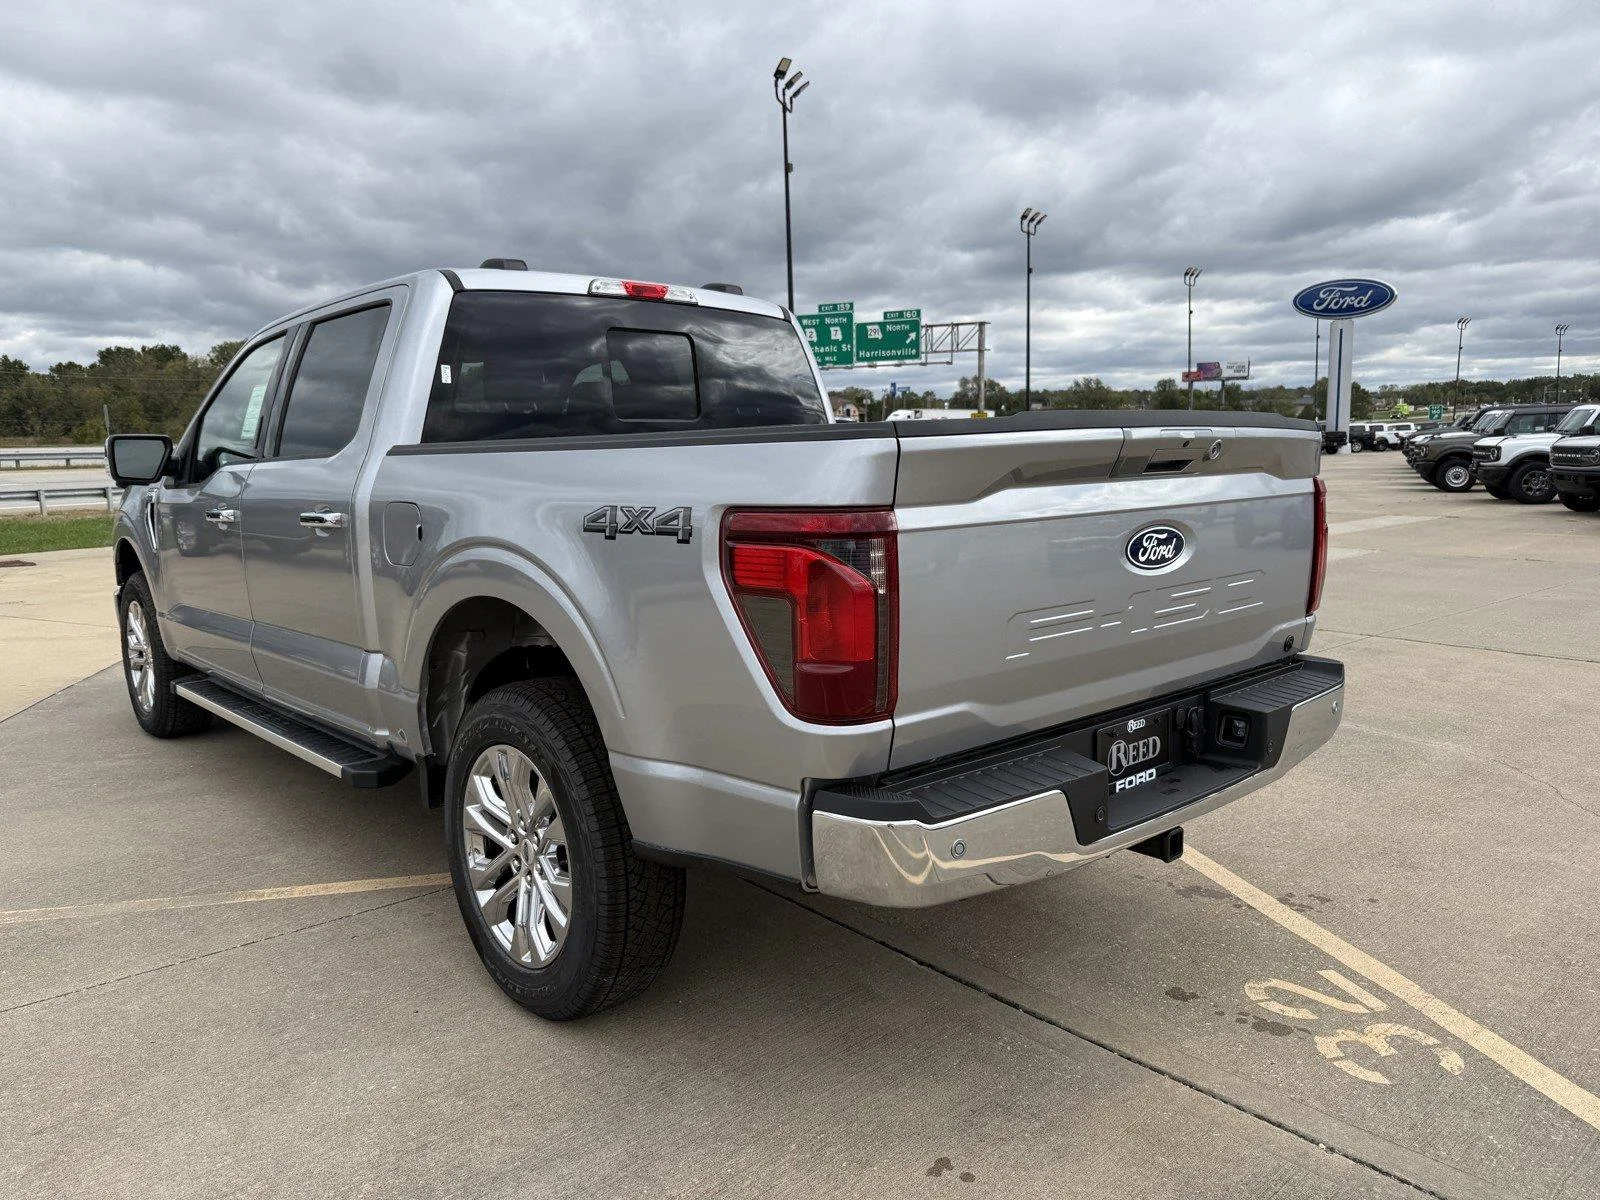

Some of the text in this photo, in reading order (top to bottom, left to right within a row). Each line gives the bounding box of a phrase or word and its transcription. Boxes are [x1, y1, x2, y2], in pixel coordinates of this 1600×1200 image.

[1313, 286, 1372, 310] Ford
[869, 328, 880, 336] 291
[860, 348, 916, 358] Harrisonville
[583, 505, 692, 544] 4X4
[1138, 532, 1176, 562] Ford
[1116, 768, 1156, 794] FORD
[1244, 969, 1465, 1086] 32
